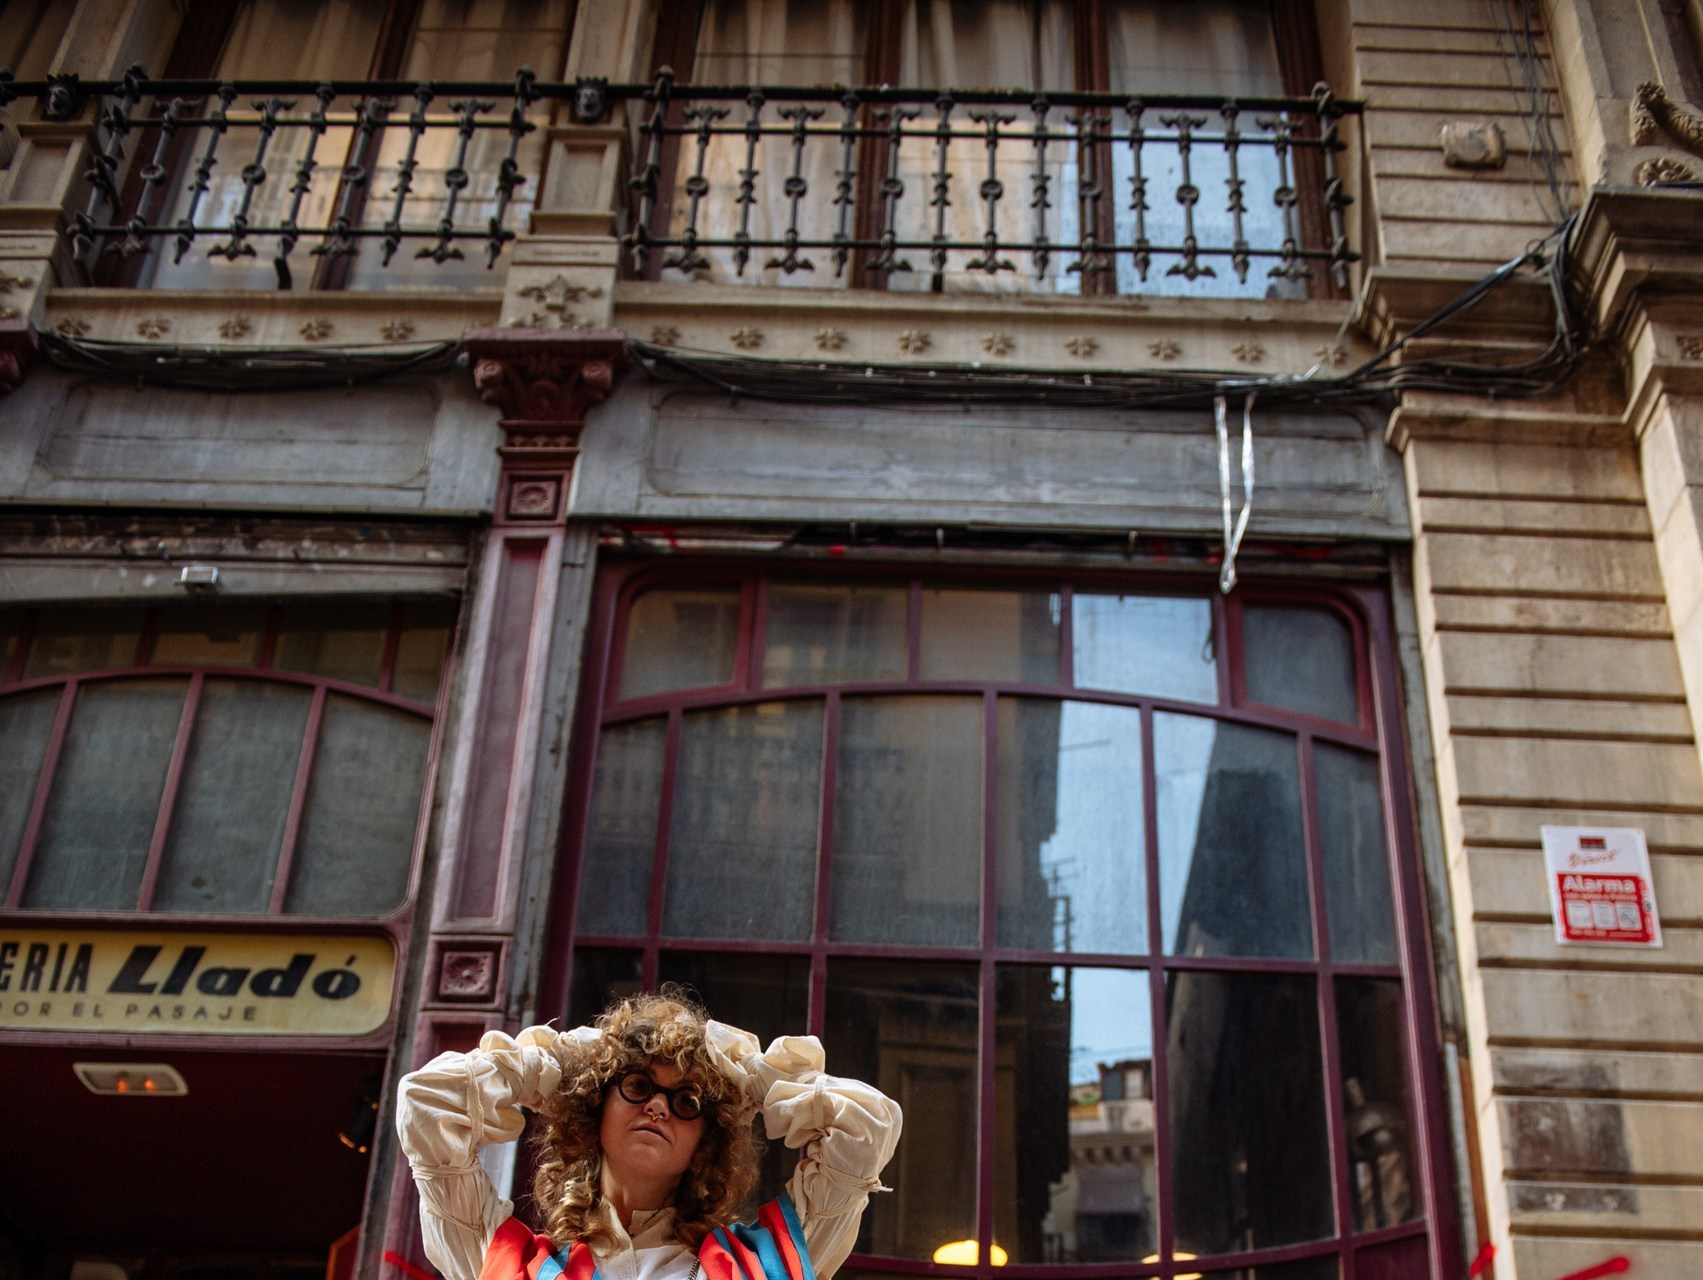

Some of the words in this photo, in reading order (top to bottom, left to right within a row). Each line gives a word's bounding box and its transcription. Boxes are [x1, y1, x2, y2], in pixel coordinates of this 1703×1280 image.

[1562, 875, 1637, 893] Alarma
[106, 945, 362, 1000] Lladó
[0, 1000, 51, 1018] OR
[71, 1002, 104, 1019] EL
[124, 1003, 258, 1021] PASAJE
